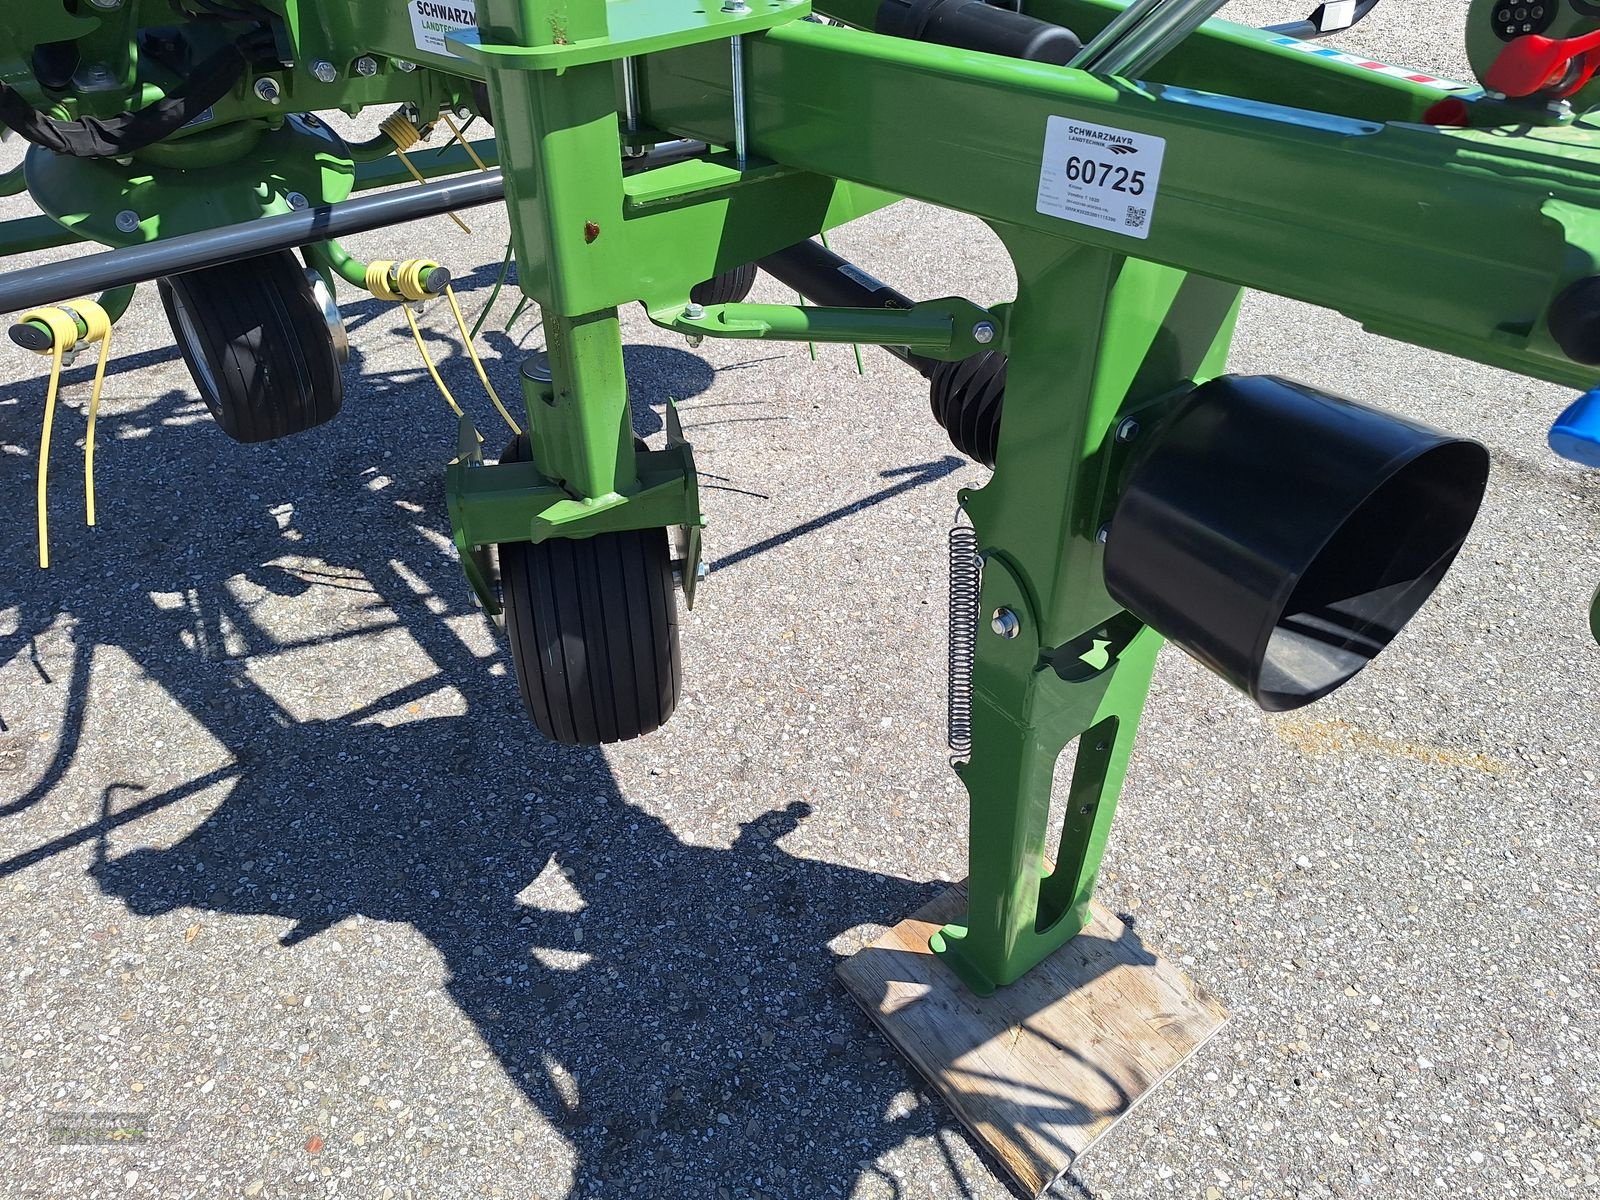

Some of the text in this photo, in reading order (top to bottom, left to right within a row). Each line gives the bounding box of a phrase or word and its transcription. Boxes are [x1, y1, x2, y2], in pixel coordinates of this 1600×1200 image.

[416, 0, 479, 26] SCHWARZM
[1068, 125, 1134, 146] SCHWARZMAYR
[1068, 135, 1106, 148] LANDTECHNIK
[1065, 156, 1146, 196] 60725
